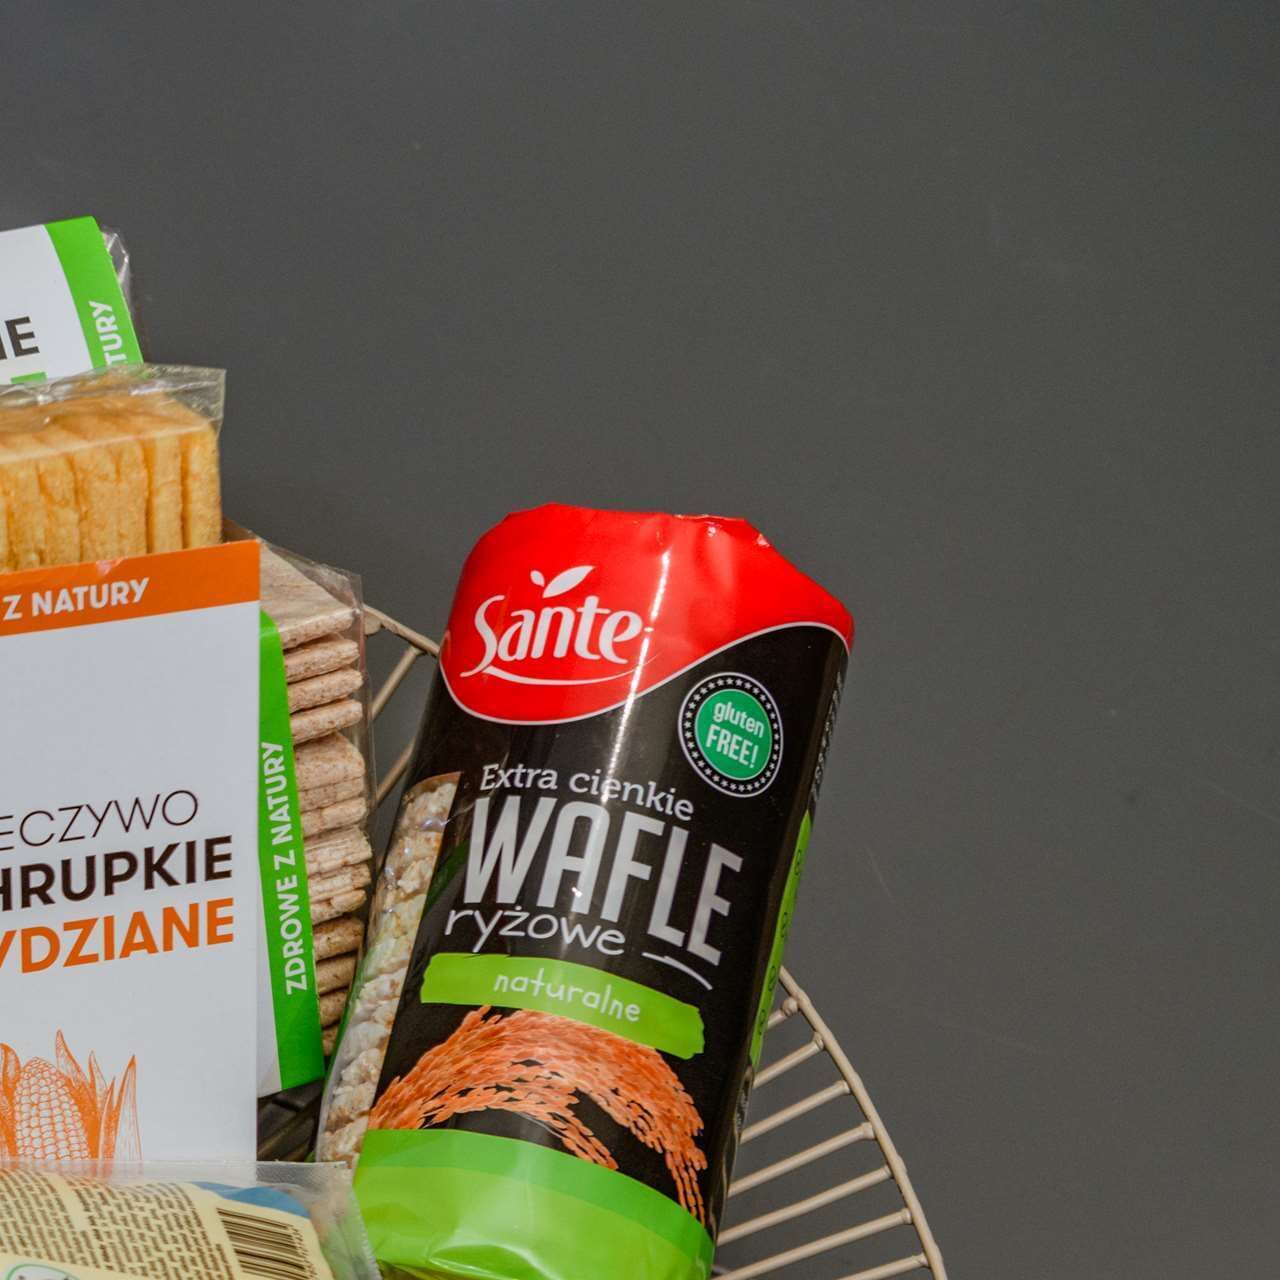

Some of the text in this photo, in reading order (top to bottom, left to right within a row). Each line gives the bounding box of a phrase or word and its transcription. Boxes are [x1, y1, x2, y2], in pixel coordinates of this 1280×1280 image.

[87, 299, 129, 366] TURY
[1, 593, 24, 622] Z
[30, 576, 151, 618] NATURY
[458, 594, 645, 679] Sante
[704, 722, 760, 770] FREE!
[712, 700, 765, 739] gluten
[480, 762, 695, 821] Extra cienkie
[260, 741, 309, 996] ZDROWE Z NATURY
[462, 794, 744, 967] WAFLE
[444, 904, 627, 956] ryżowe
[492, 967, 642, 1022] naturalne
